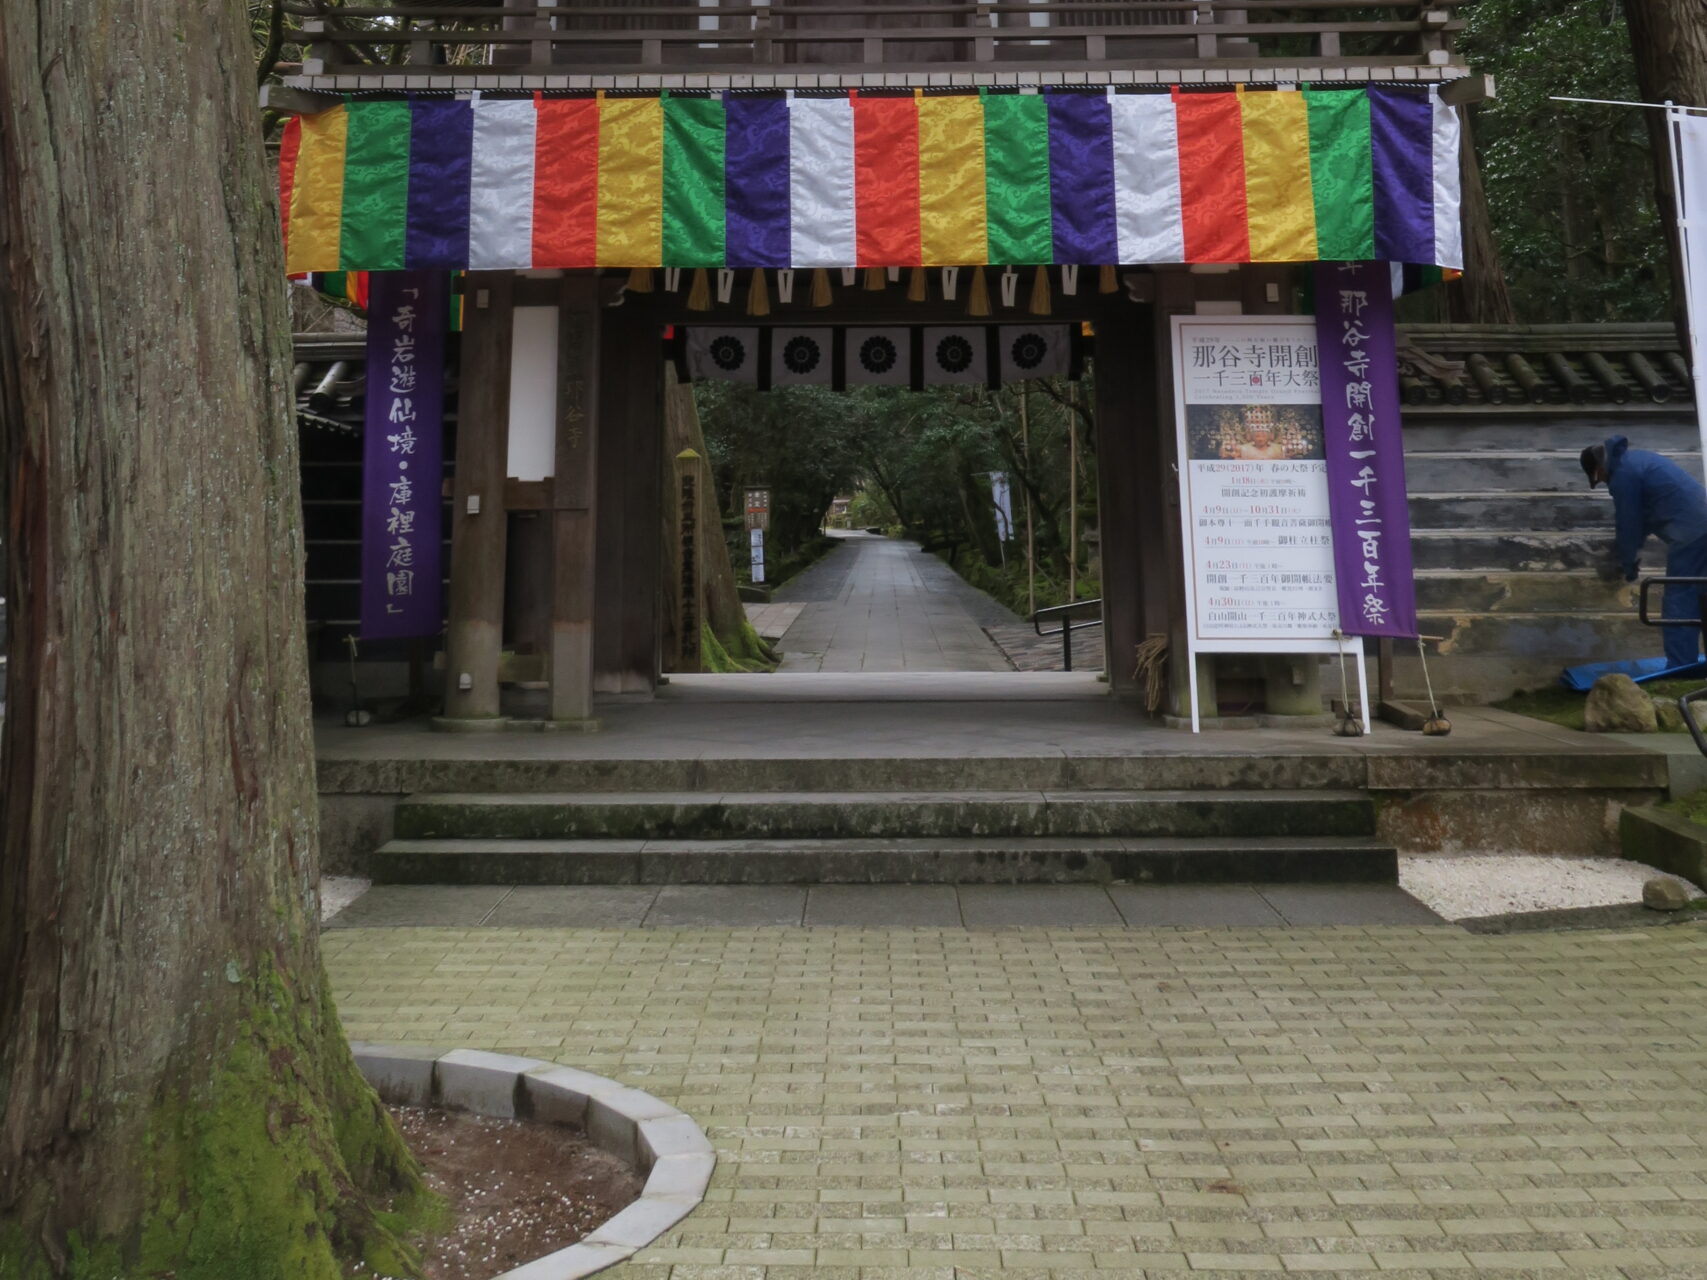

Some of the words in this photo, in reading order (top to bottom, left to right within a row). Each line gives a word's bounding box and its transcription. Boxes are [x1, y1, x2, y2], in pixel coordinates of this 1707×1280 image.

[1192, 344, 1318, 368] 那谷寺開創
[1193, 369, 1319, 387] 一千三百年大祭
